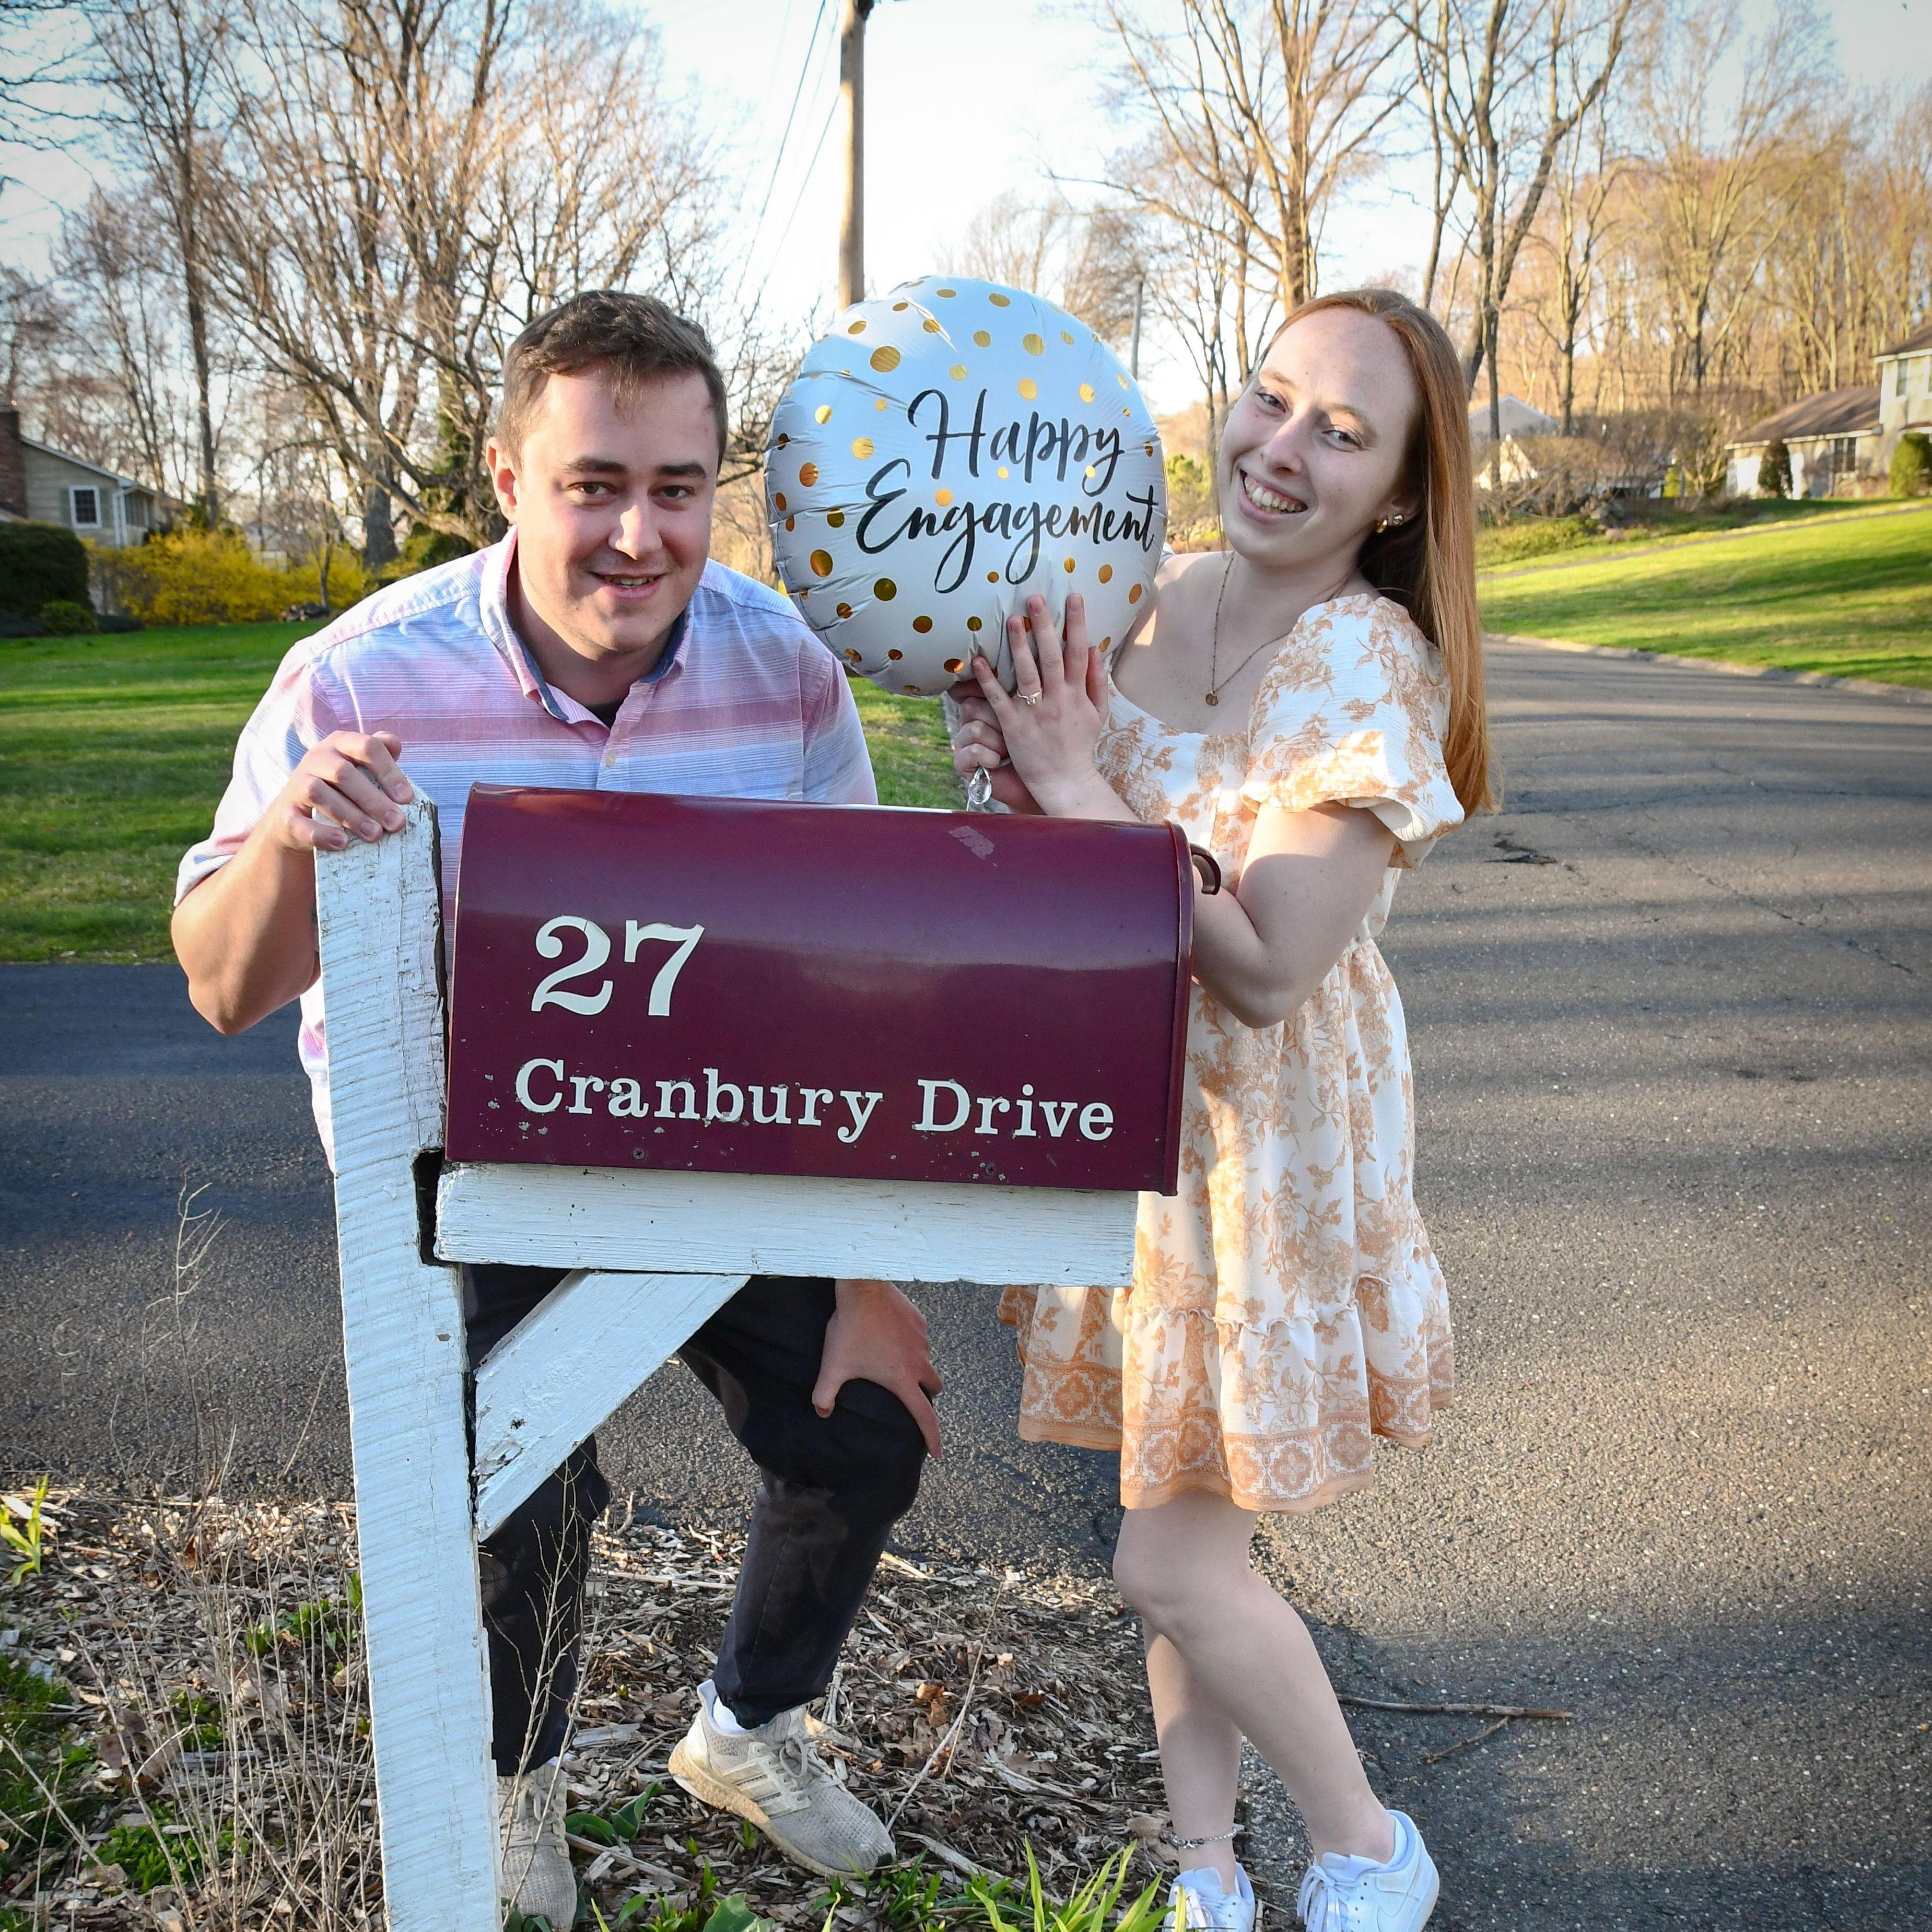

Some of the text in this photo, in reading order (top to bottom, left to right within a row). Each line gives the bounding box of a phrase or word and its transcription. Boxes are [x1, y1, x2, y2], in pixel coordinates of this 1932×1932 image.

[907, 388, 1125, 497] Happy
[856, 458, 1155, 593] Engagement
[531, 915, 705, 1016] 27
[516, 1058, 1114, 1143] Cranbury Drive
